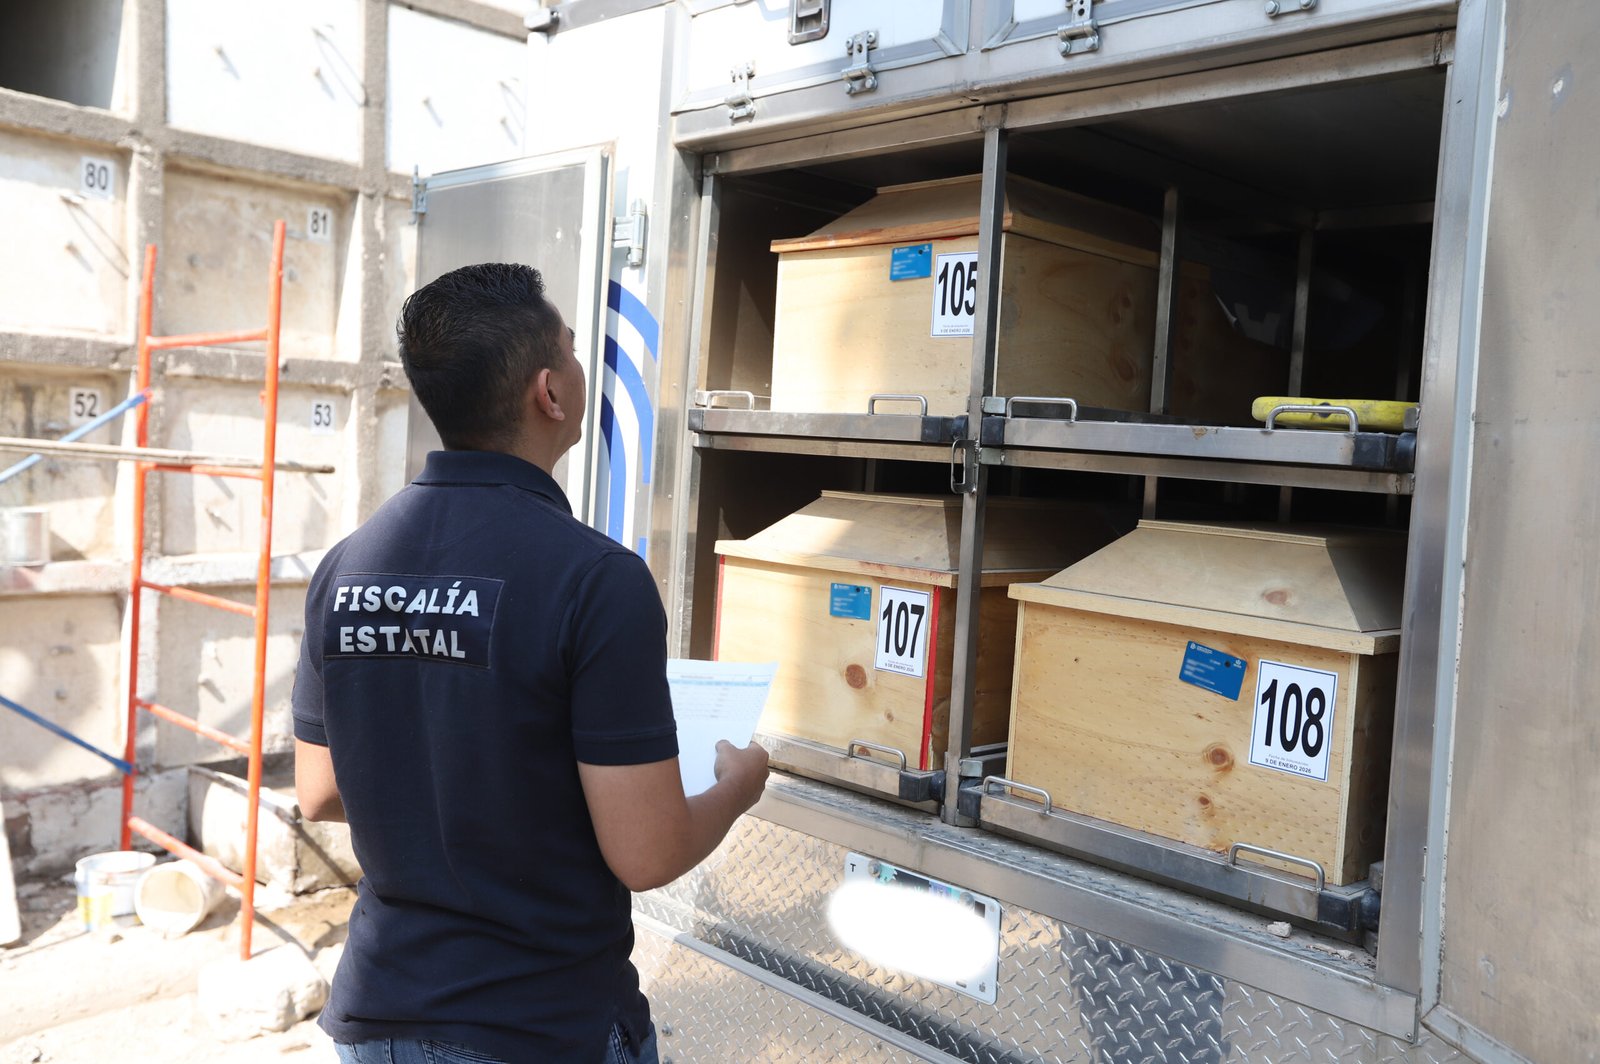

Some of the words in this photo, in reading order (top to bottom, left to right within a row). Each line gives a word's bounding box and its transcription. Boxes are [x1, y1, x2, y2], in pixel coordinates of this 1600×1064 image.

[85, 162, 109, 190] 80
[311, 210, 327, 235] 81
[938, 261, 978, 316] 105
[75, 393, 97, 417] 52
[314, 404, 331, 426] 53
[333, 581, 479, 617] FISCALÍA
[339, 626, 466, 659] ESTATAL
[882, 599, 925, 659] 107
[1261, 679, 1326, 758] 108
[1278, 761, 1298, 770] ENERO
[1298, 766, 1312, 774] 2026
